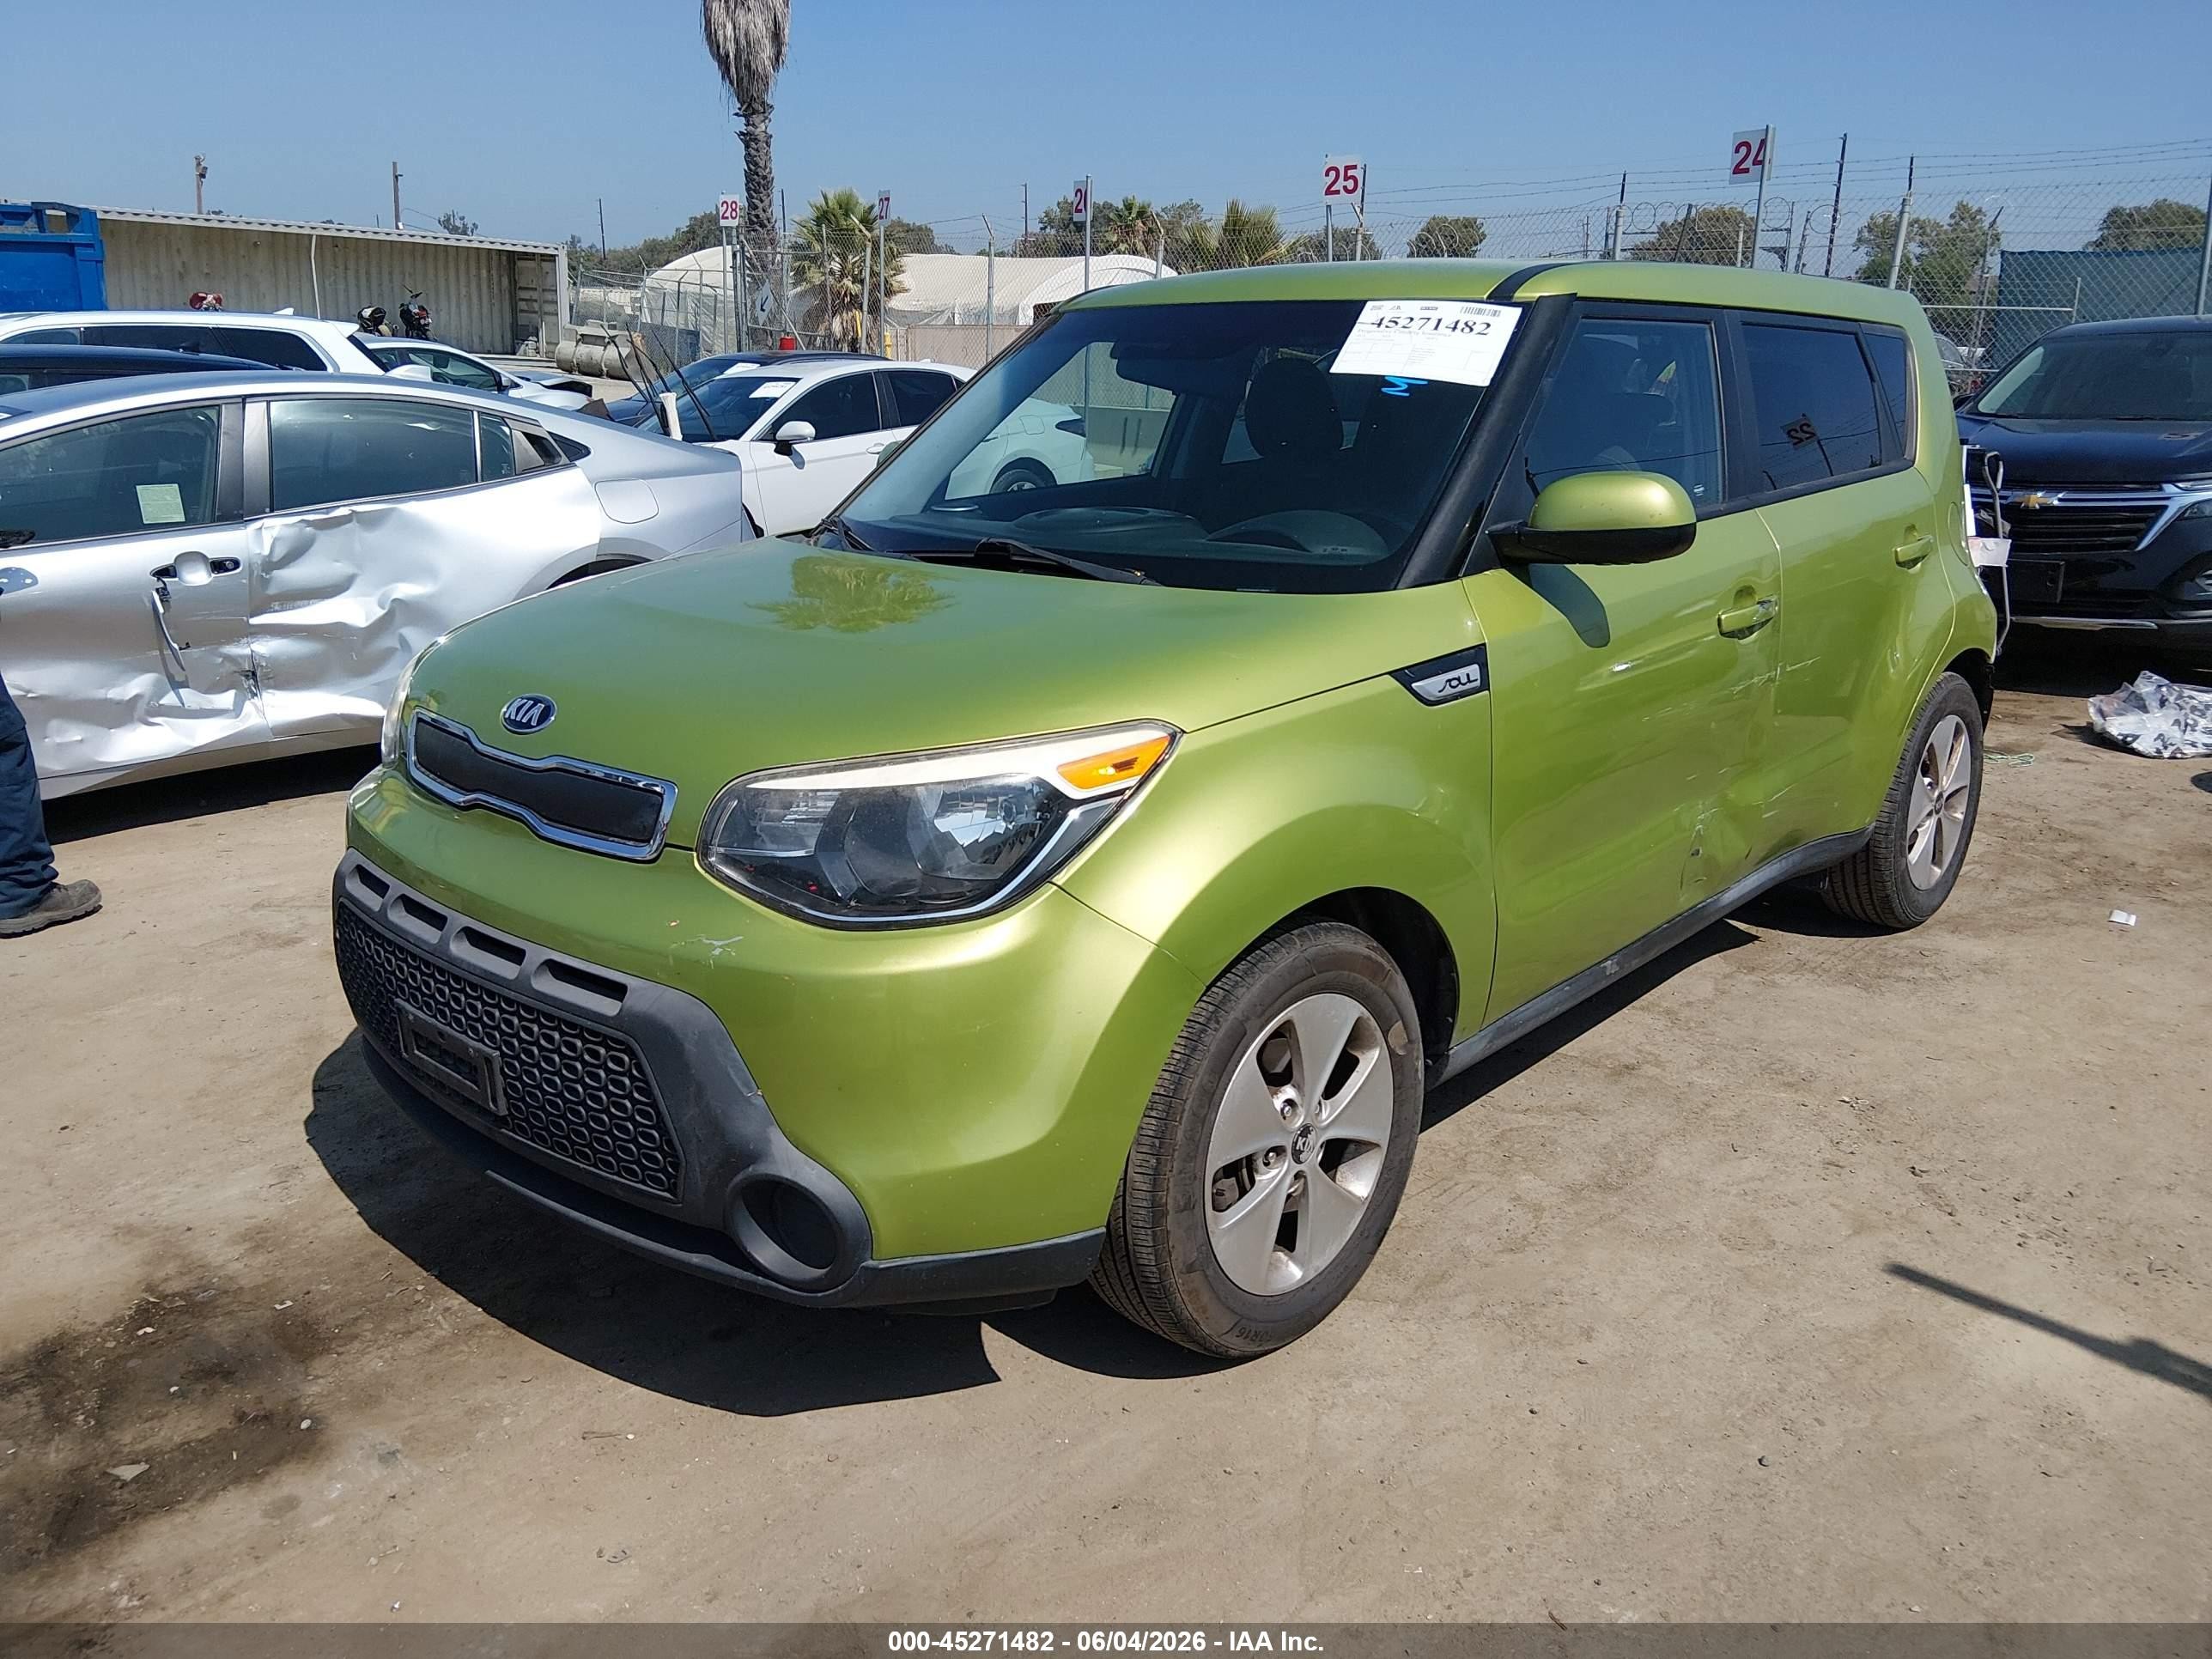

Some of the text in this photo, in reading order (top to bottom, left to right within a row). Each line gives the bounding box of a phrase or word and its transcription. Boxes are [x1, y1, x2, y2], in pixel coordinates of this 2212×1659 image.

[1324, 164, 1358, 196] 25
[721, 200, 738, 220] 28
[878, 197, 890, 220] 27
[1370, 316, 1492, 336] 45271482
[504, 698, 544, 726] KIA
